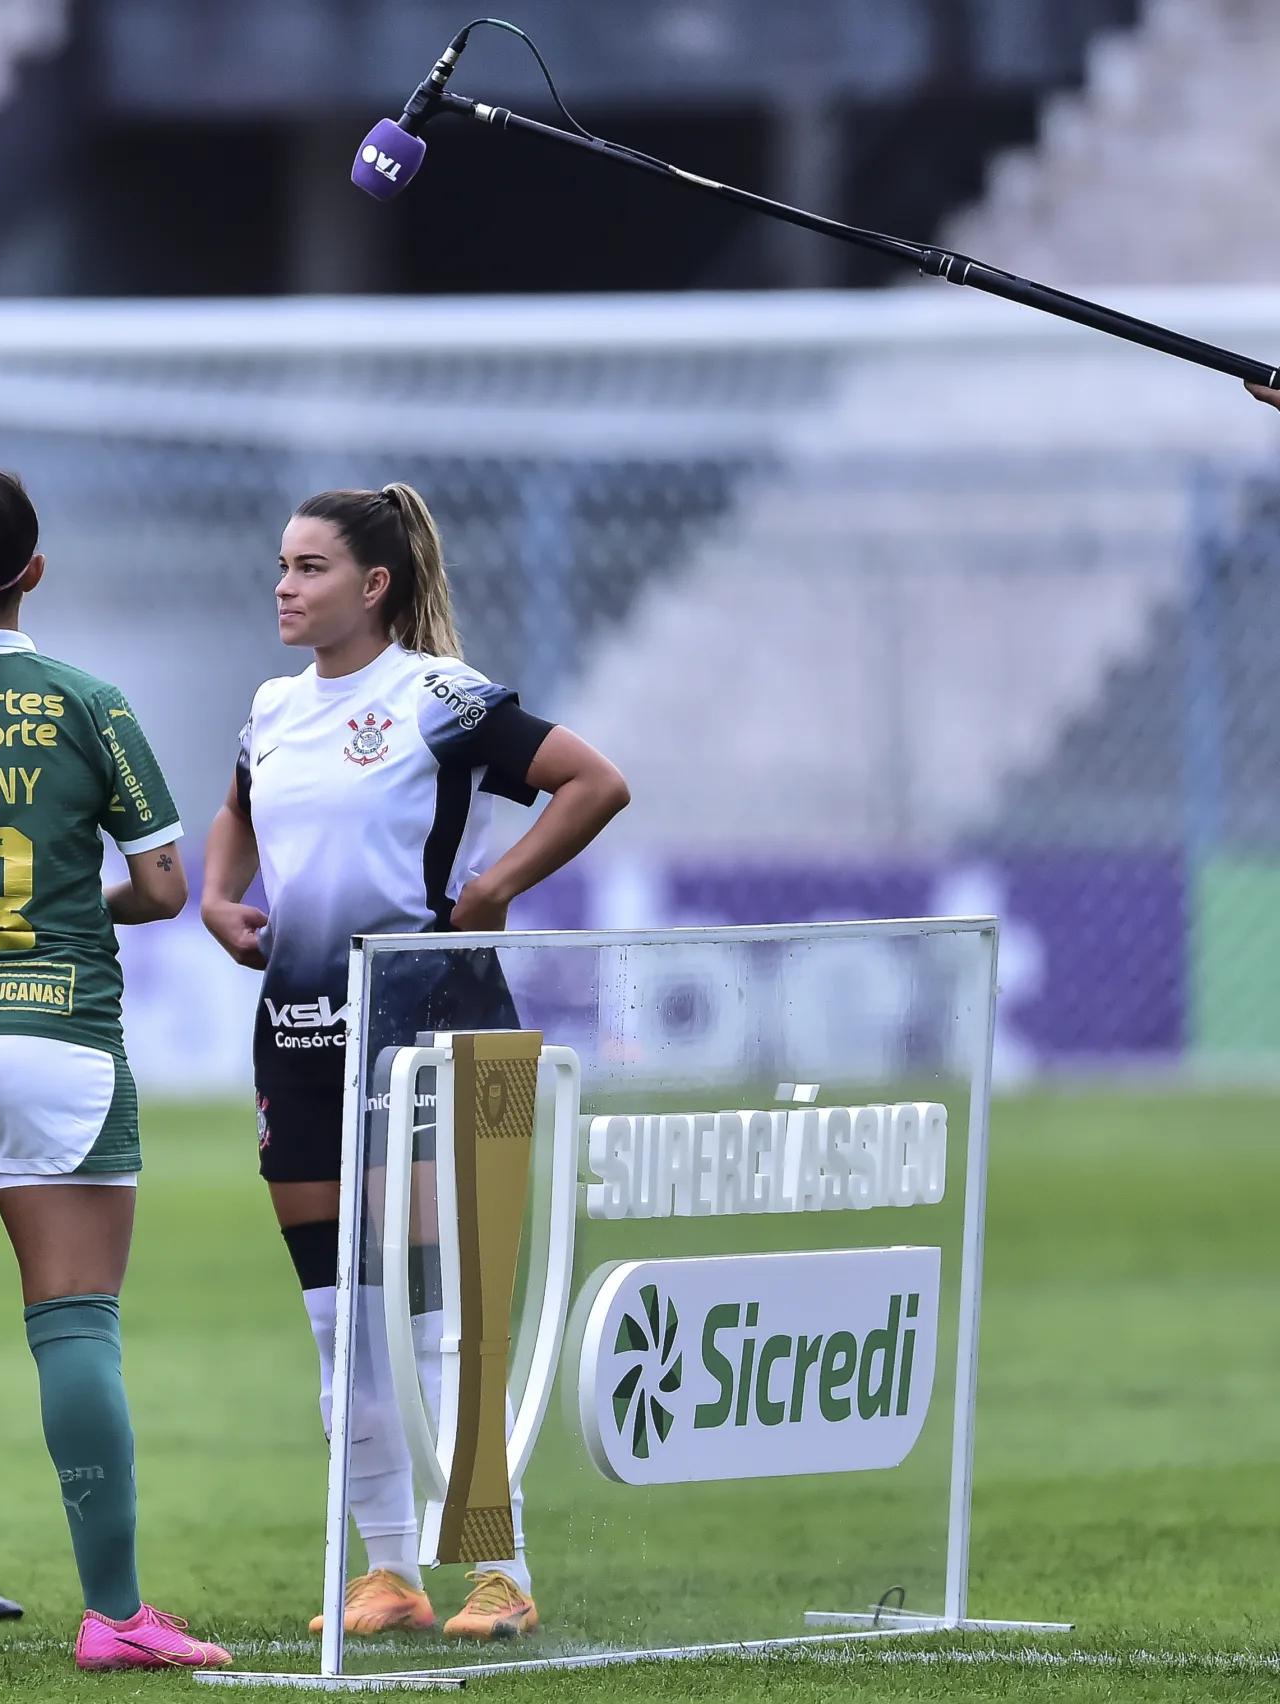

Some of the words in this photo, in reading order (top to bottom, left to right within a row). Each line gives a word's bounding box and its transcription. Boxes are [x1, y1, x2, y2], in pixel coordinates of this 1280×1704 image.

[430, 680, 487, 730] bmg
[102, 726, 153, 822] Palmeiras
[693, 1292, 920, 1429] Sicredi
